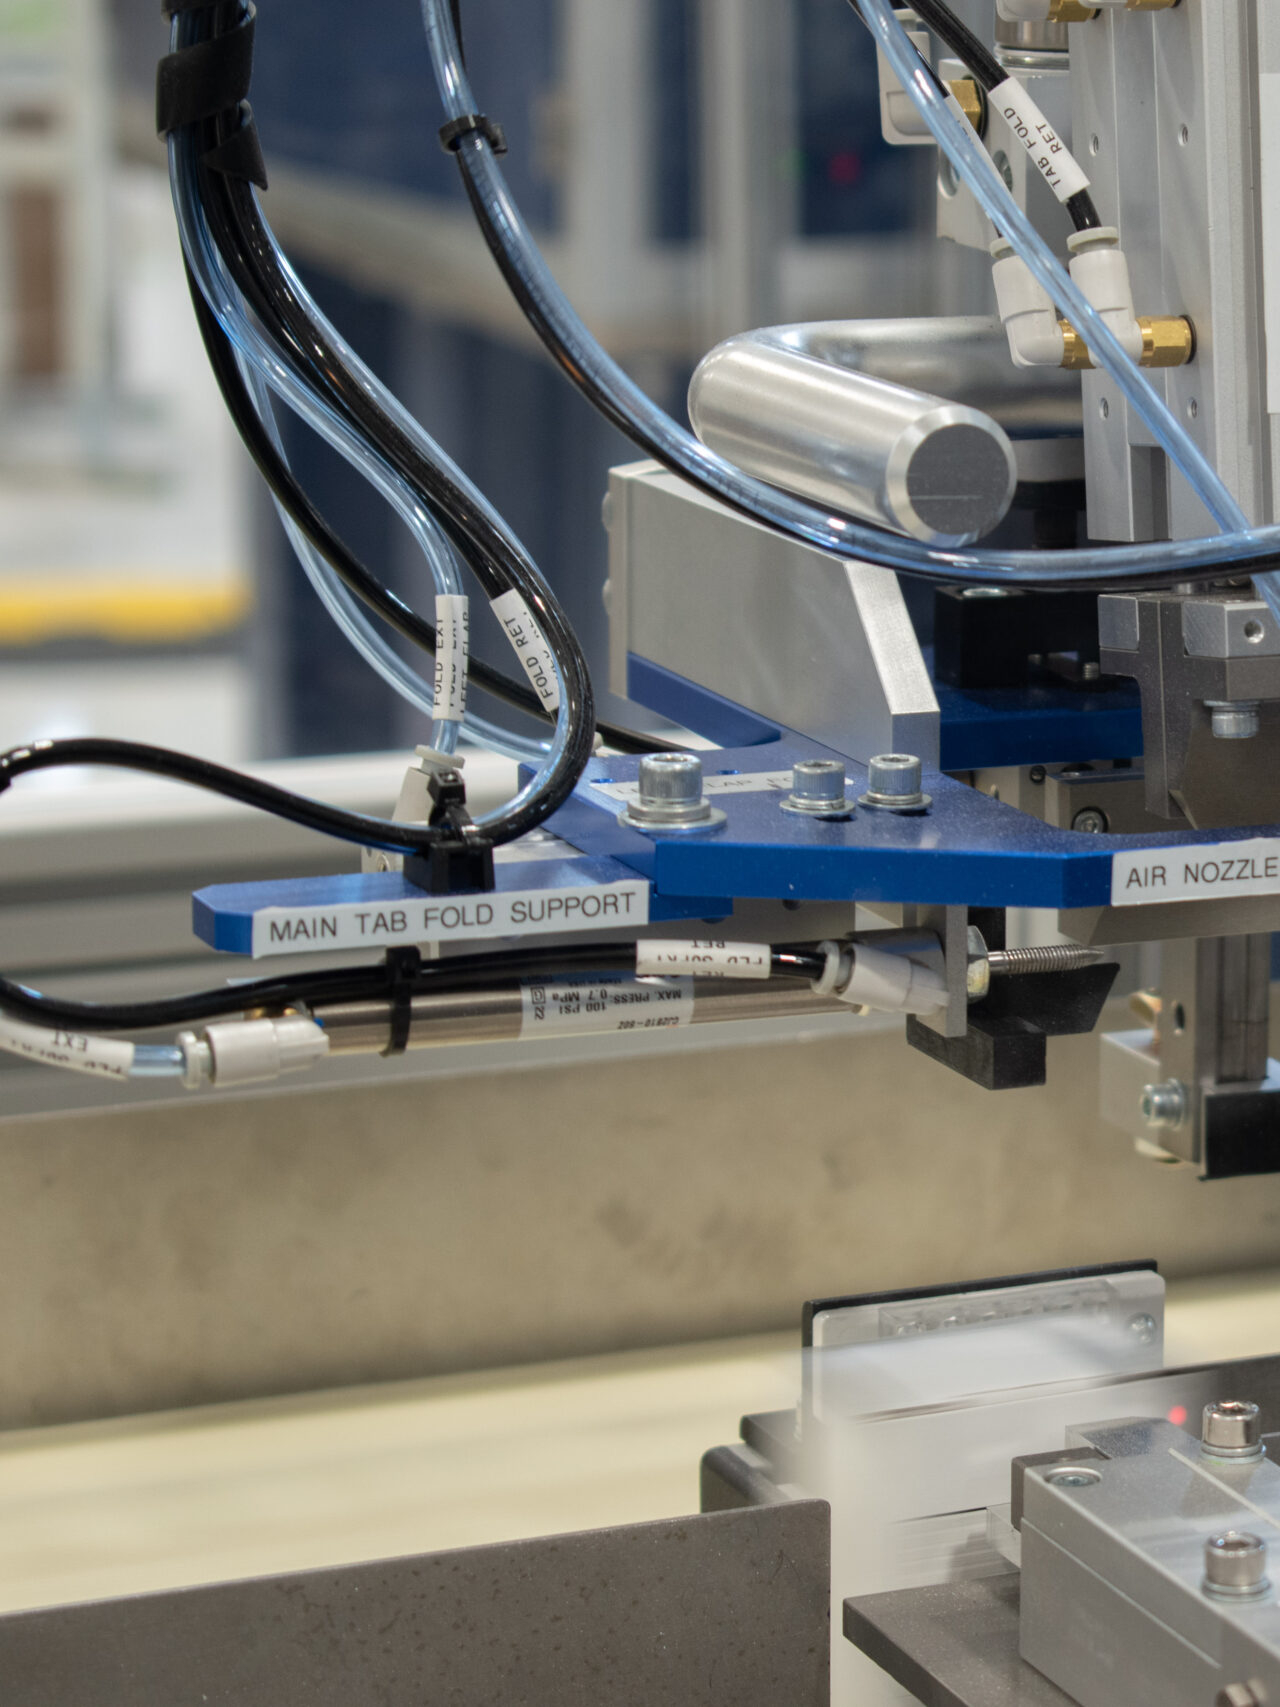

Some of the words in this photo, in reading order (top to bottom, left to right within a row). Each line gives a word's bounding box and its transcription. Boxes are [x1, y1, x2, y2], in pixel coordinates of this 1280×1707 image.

[1003, 106, 1037, 149] FOLD
[1035, 122, 1063, 154] RET
[1037, 157, 1062, 190] TAB
[504, 616, 529, 649] RET
[526, 655, 554, 700] FOLD
[1126, 865, 1167, 889] AIR
[1183, 856, 1280, 884] NOZZLE
[269, 915, 338, 943] MAIN
[354, 910, 408, 935] TAB
[423, 902, 495, 930] FOLD
[509, 891, 637, 924] SUPPORT
[552, 990, 580, 1002] MPa
[560, 1002, 580, 1015] PSI
[586, 1001, 607, 1013] 100
[587, 988, 608, 1000] 0.7
[655, 988, 683, 1001] MAX.
